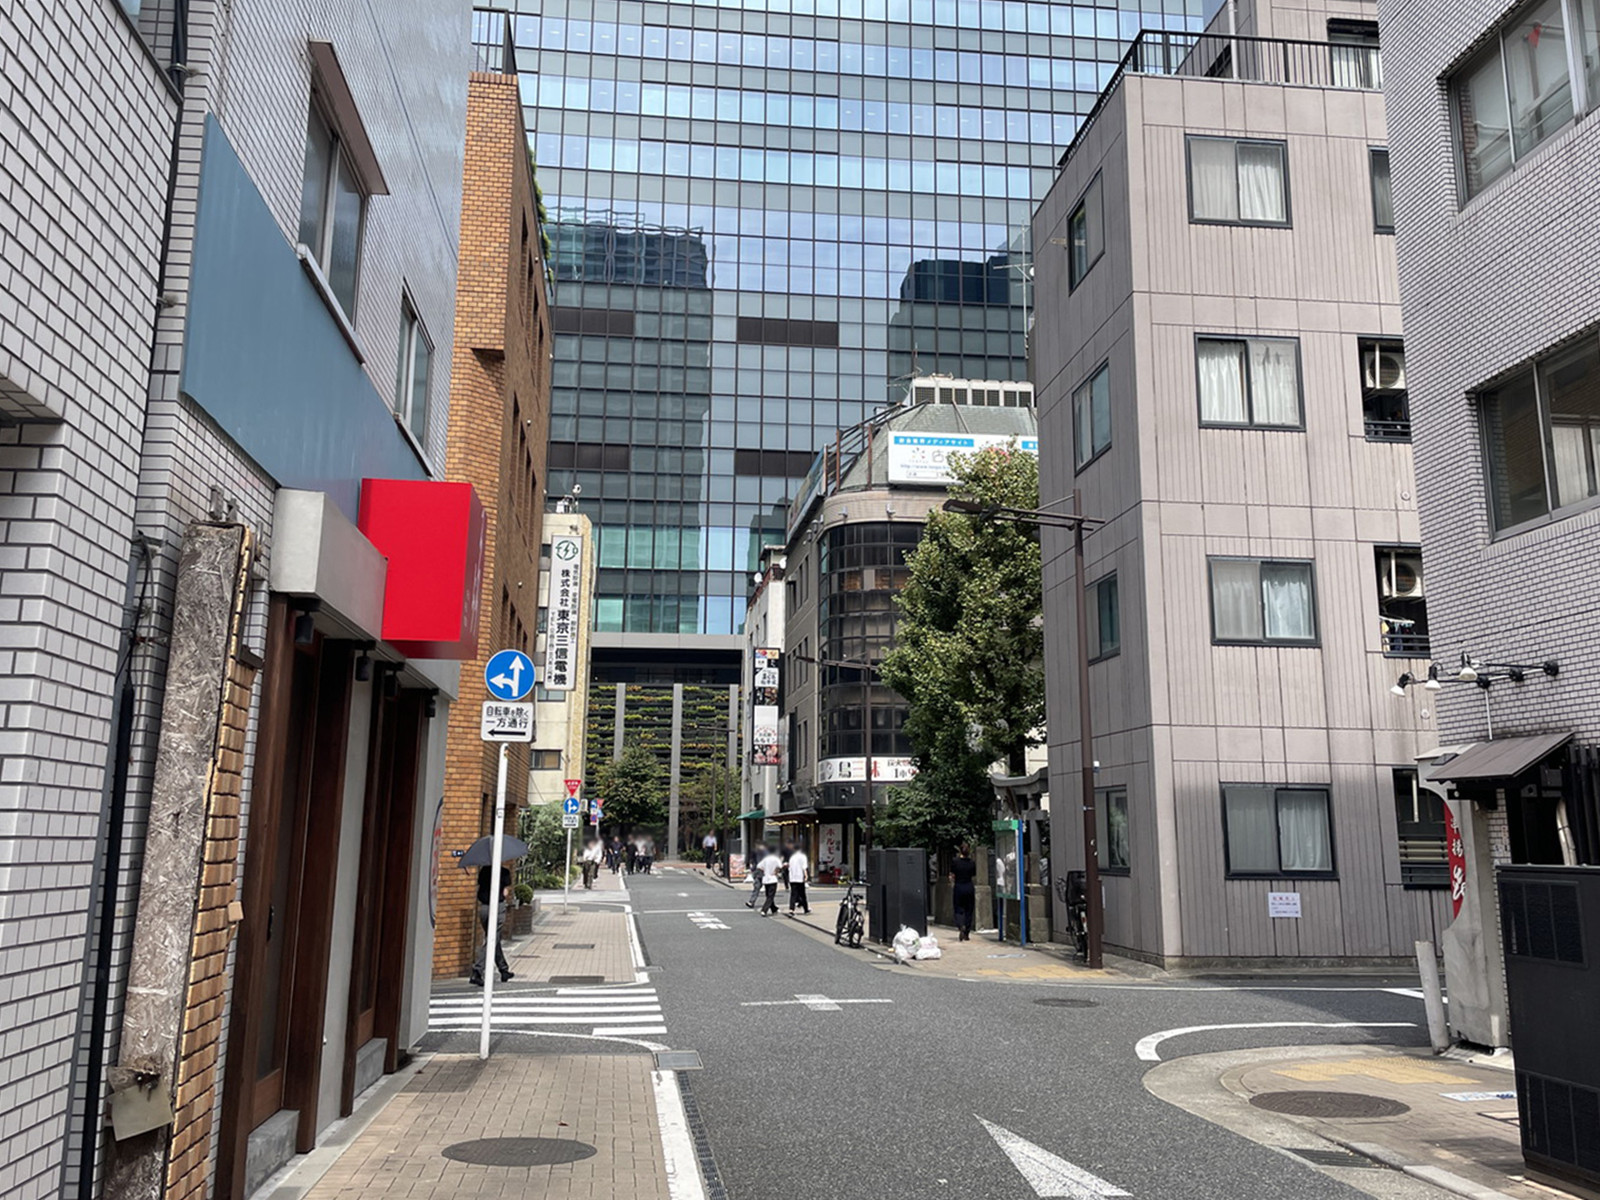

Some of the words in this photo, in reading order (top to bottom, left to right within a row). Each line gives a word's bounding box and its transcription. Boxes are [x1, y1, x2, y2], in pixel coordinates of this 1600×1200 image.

[486, 705, 529, 717] 自転車を除く
[485, 717, 529, 729] 一方通行
